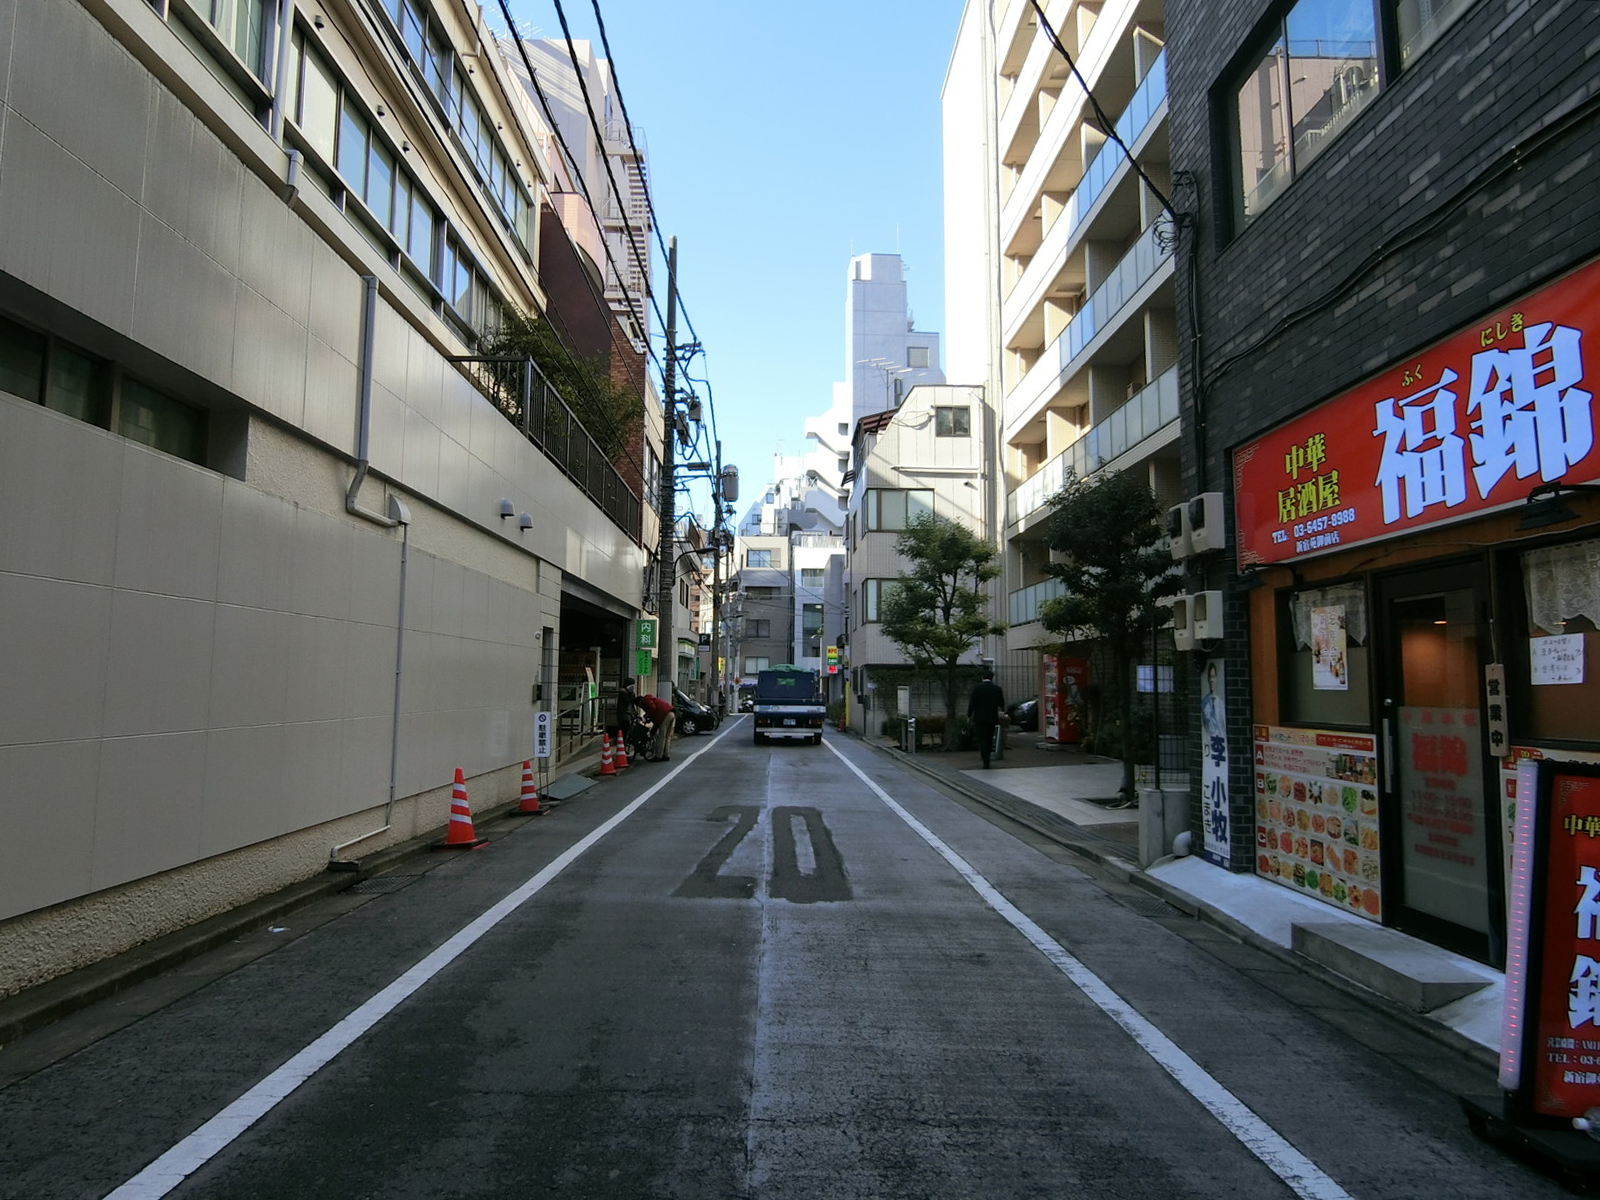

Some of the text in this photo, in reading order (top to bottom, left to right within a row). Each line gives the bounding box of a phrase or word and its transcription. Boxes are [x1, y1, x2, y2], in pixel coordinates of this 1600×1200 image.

[1401, 312, 1524, 387] ふく にしき
[1372, 321, 1594, 525] 福錦
[1284, 432, 1327, 481] 中華
[1277, 469, 1341, 524] 居酒屋
[1293, 507, 1356, 538] 03-6457-8988
[640, 622, 652, 645] 内科
[1488, 679, 1503, 748] 営業中
[1210, 735, 1226, 767] 李
[1256, 751, 1263, 759] A
[1257, 778, 1265, 788] B
[1211, 776, 1228, 845] 小牧
[1564, 1070, 1600, 1085] 新宿御
